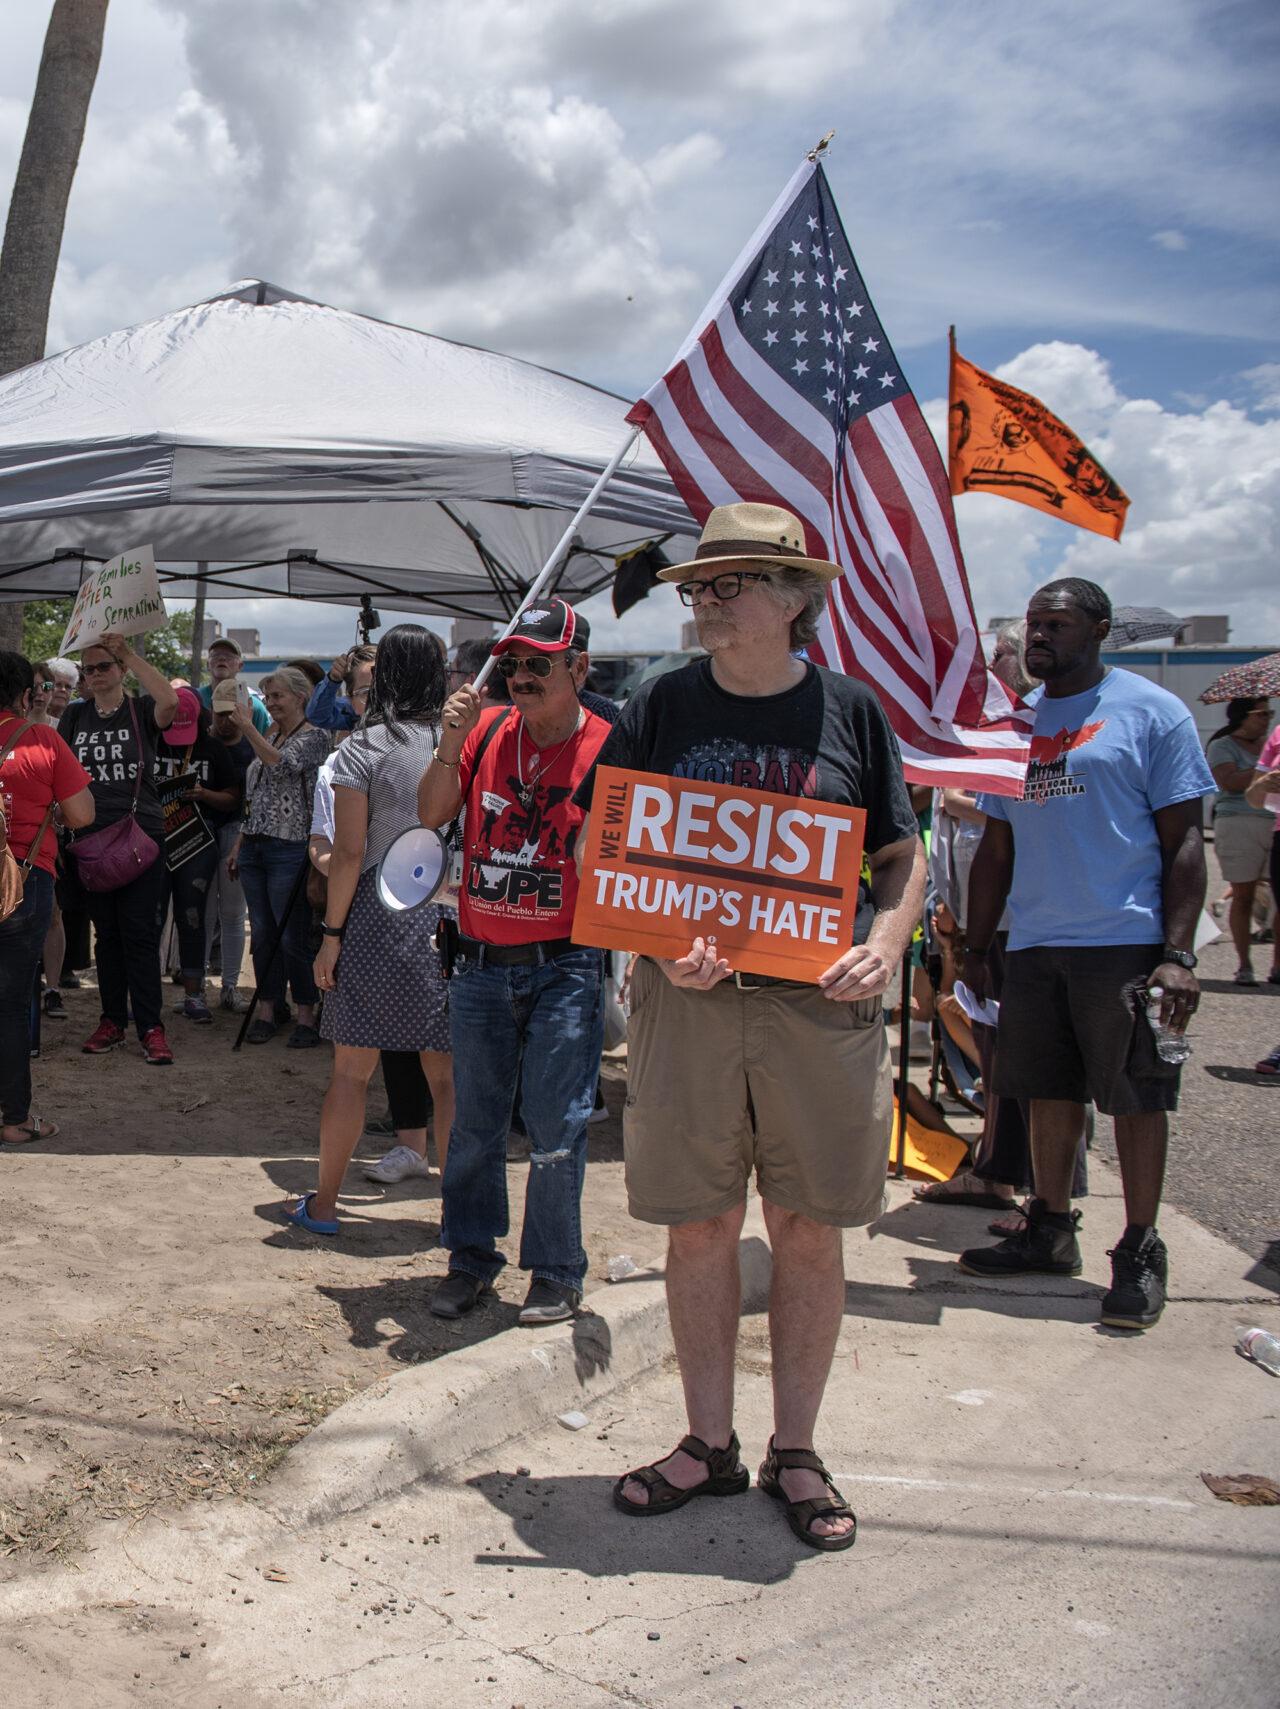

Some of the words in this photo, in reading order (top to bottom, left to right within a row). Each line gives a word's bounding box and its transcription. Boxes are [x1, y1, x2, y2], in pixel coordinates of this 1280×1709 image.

[75, 729, 130, 745] BETO
[78, 744, 123, 763] FOR
[733, 760, 816, 798] BAN
[1038, 785, 1085, 798] CAROLINA
[1047, 778, 1074, 788] HOME
[605, 781, 628, 825] WILL
[599, 826, 621, 860] WE
[626, 783, 852, 881] RESIST
[467, 862, 562, 909] LUPE
[493, 904, 505, 912] del
[507, 906, 532, 915] Pueblo
[535, 909, 558, 917] Entero
[593, 868, 743, 927] TRUMP'S
[749, 895, 841, 945] HATE
